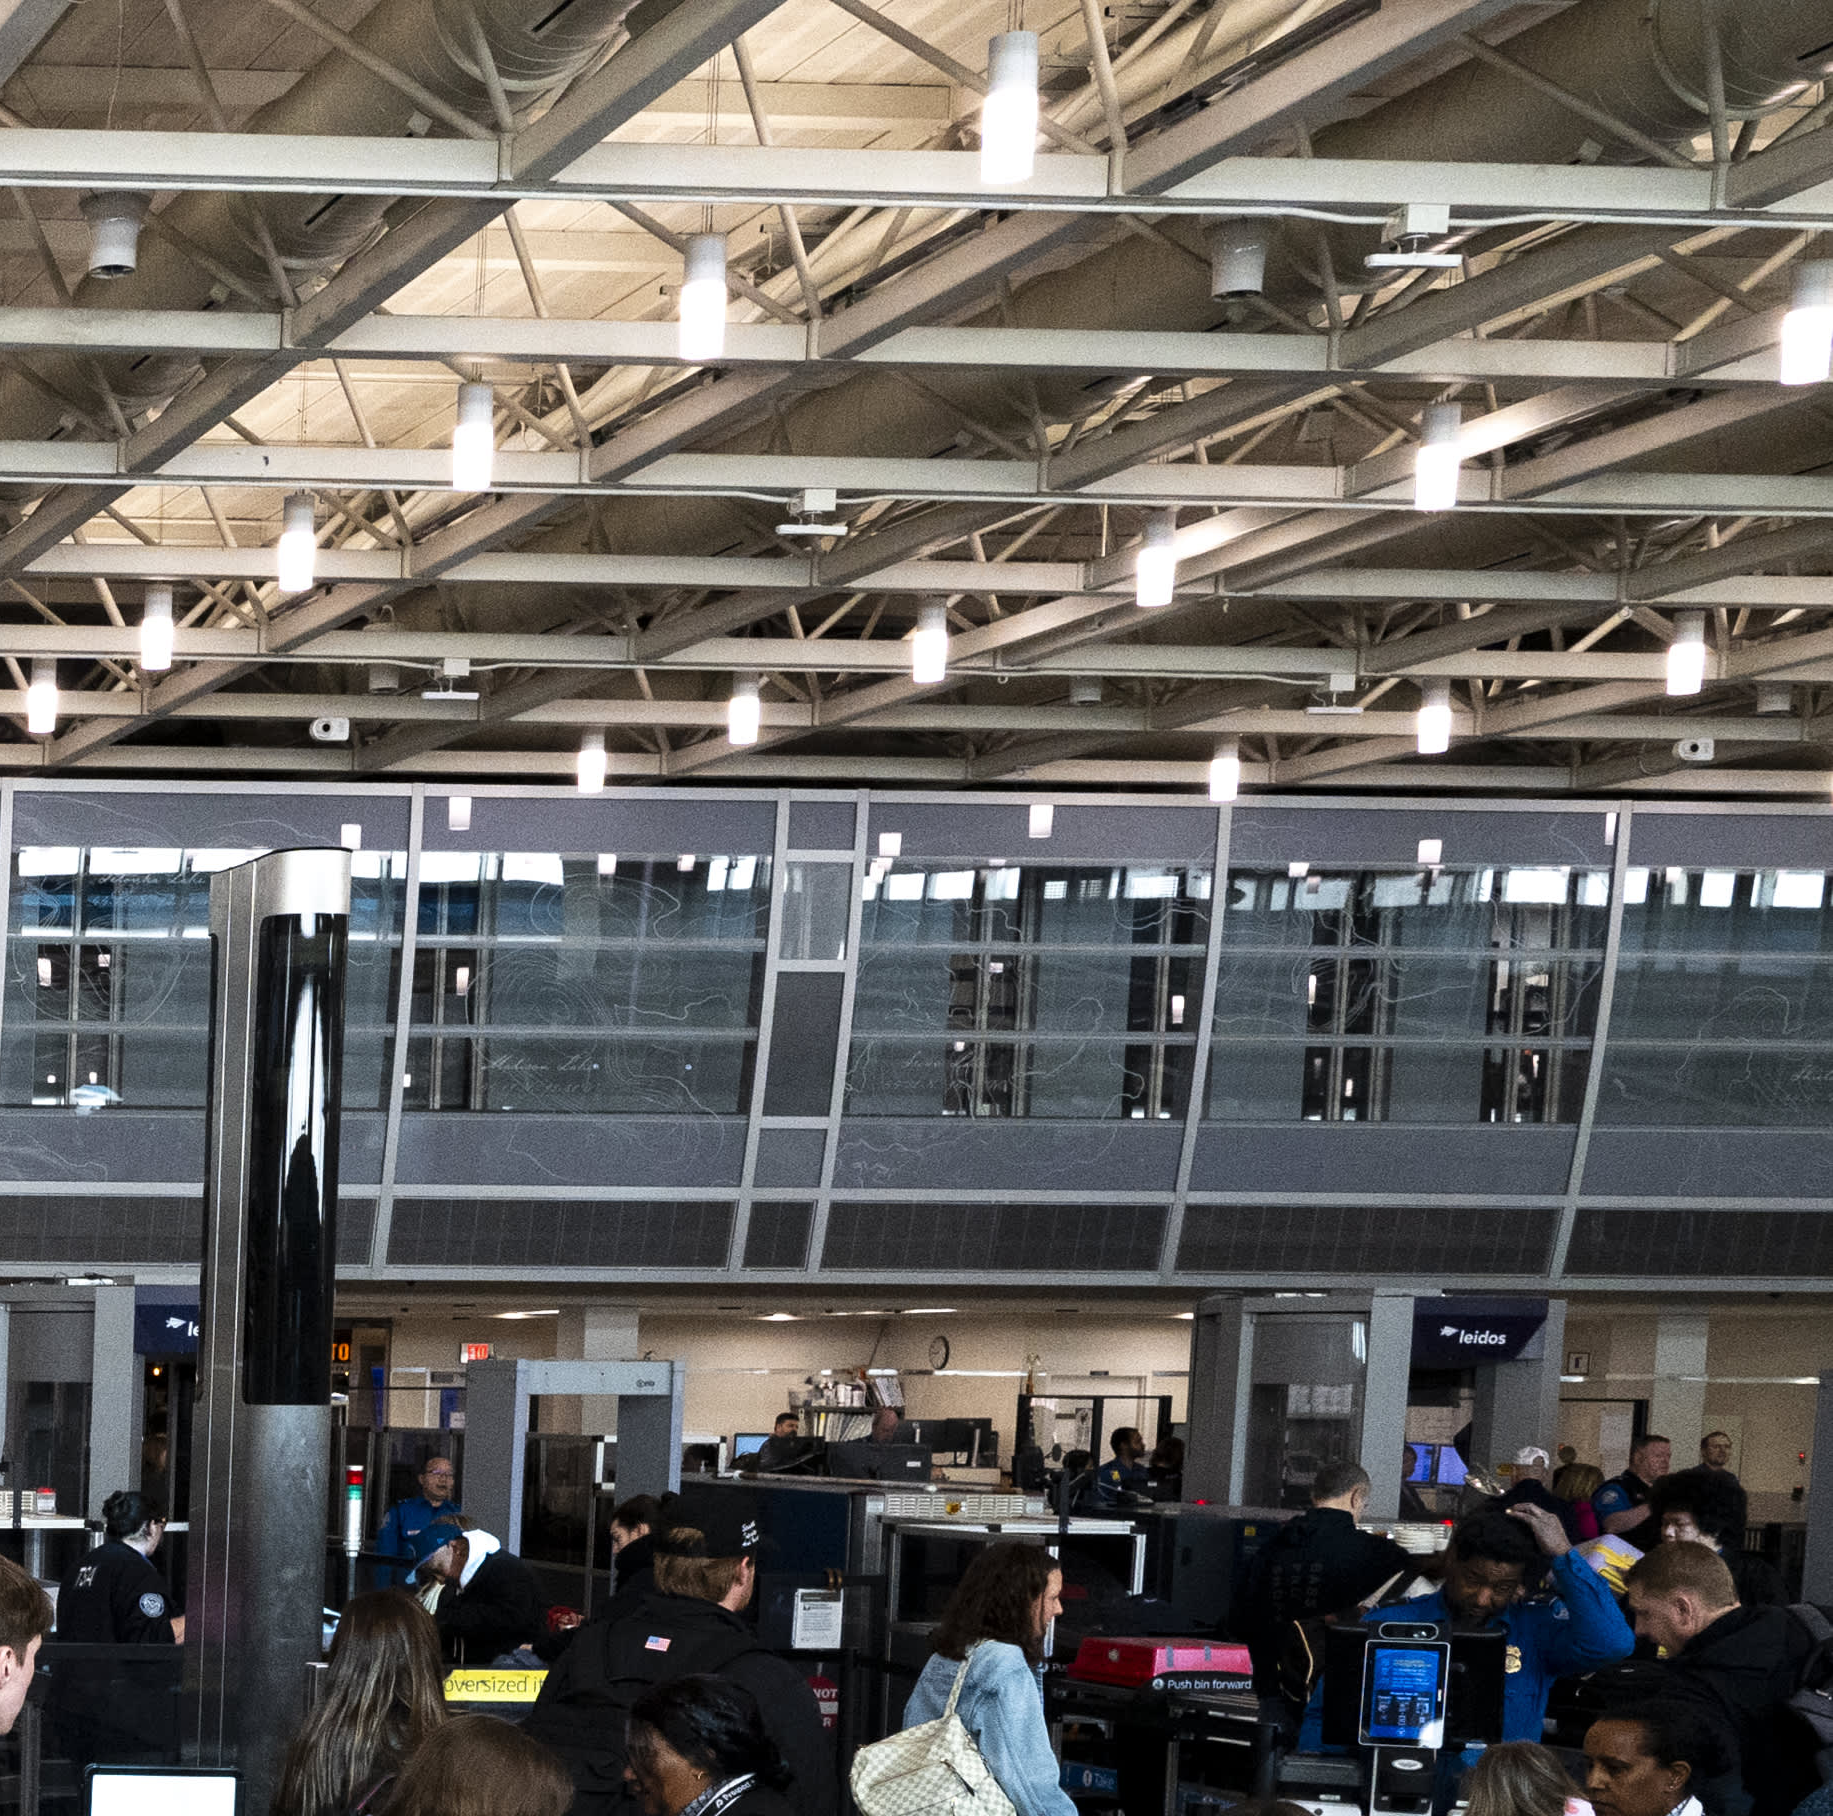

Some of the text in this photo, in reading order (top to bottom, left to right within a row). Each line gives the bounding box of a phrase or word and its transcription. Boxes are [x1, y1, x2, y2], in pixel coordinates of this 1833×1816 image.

[1459, 1330, 1506, 1345] leidos
[445, 1675, 528, 1694] oversized
[1167, 1679, 1252, 1691] Push bin forward
